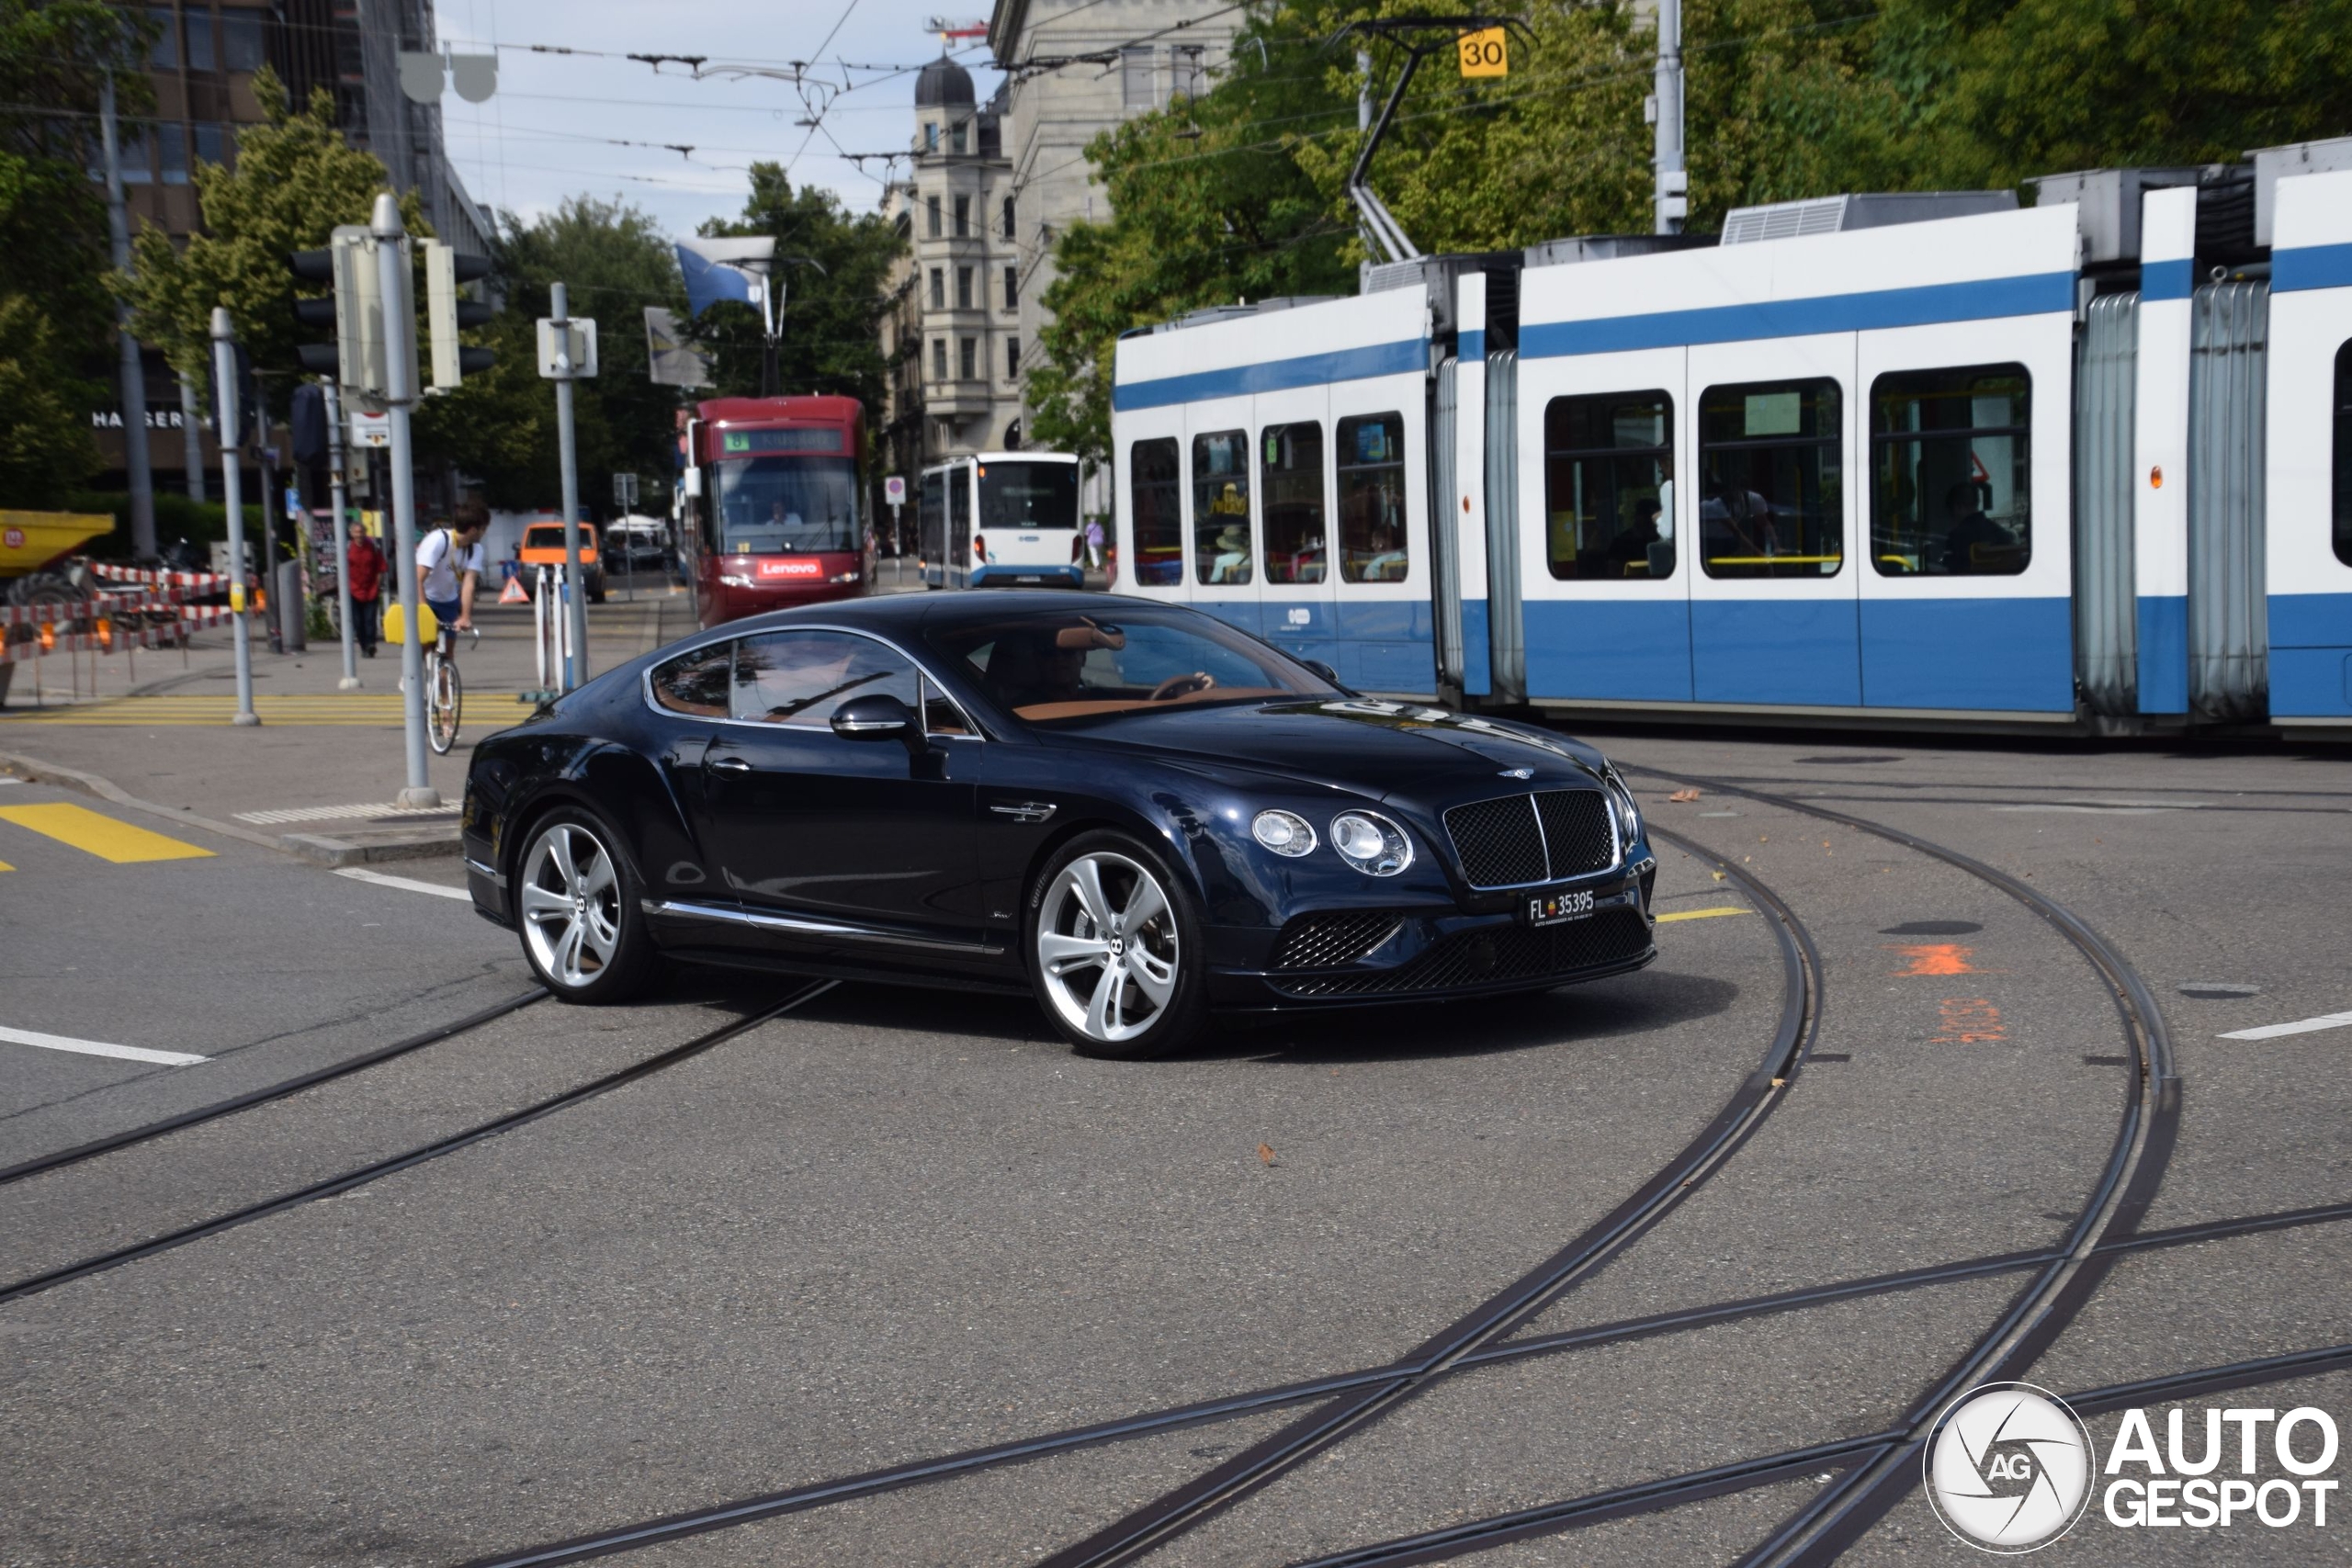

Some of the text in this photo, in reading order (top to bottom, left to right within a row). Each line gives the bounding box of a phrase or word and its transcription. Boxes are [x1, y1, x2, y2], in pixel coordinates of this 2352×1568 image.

[1464, 41, 1502, 67] 30
[93, 412, 183, 428] HASER
[763, 563, 817, 574] Lenovo
[1531, 890, 1594, 919] FL 35395
